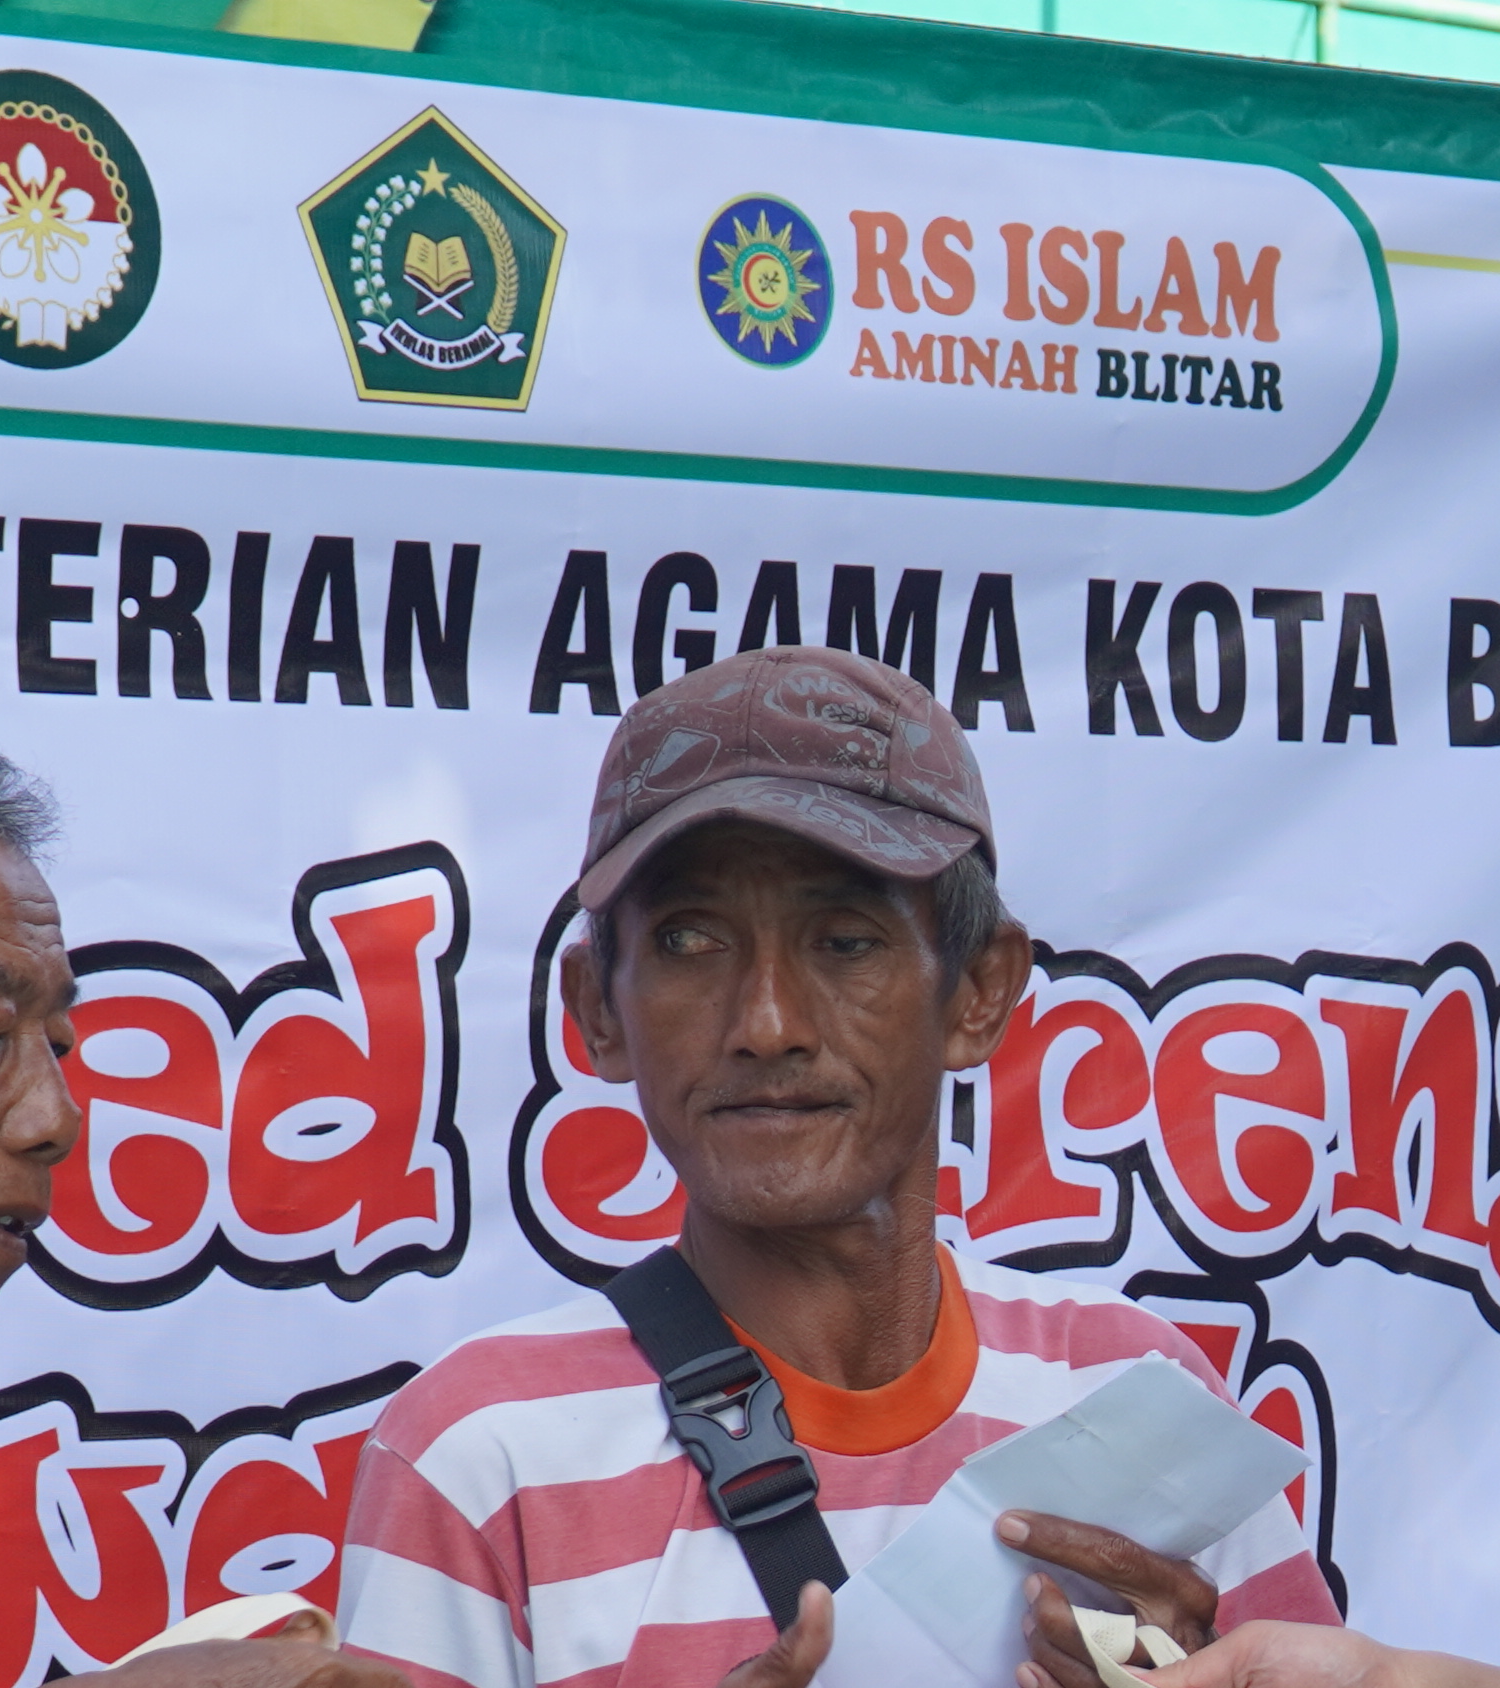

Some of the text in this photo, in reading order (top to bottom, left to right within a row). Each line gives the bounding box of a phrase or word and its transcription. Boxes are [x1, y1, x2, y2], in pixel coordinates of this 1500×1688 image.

[848, 209, 976, 317] RS
[999, 222, 1282, 344] ISLAM
[849, 327, 1284, 412] AMINAH BLITAR
[1085, 578, 1399, 746] KOTA
